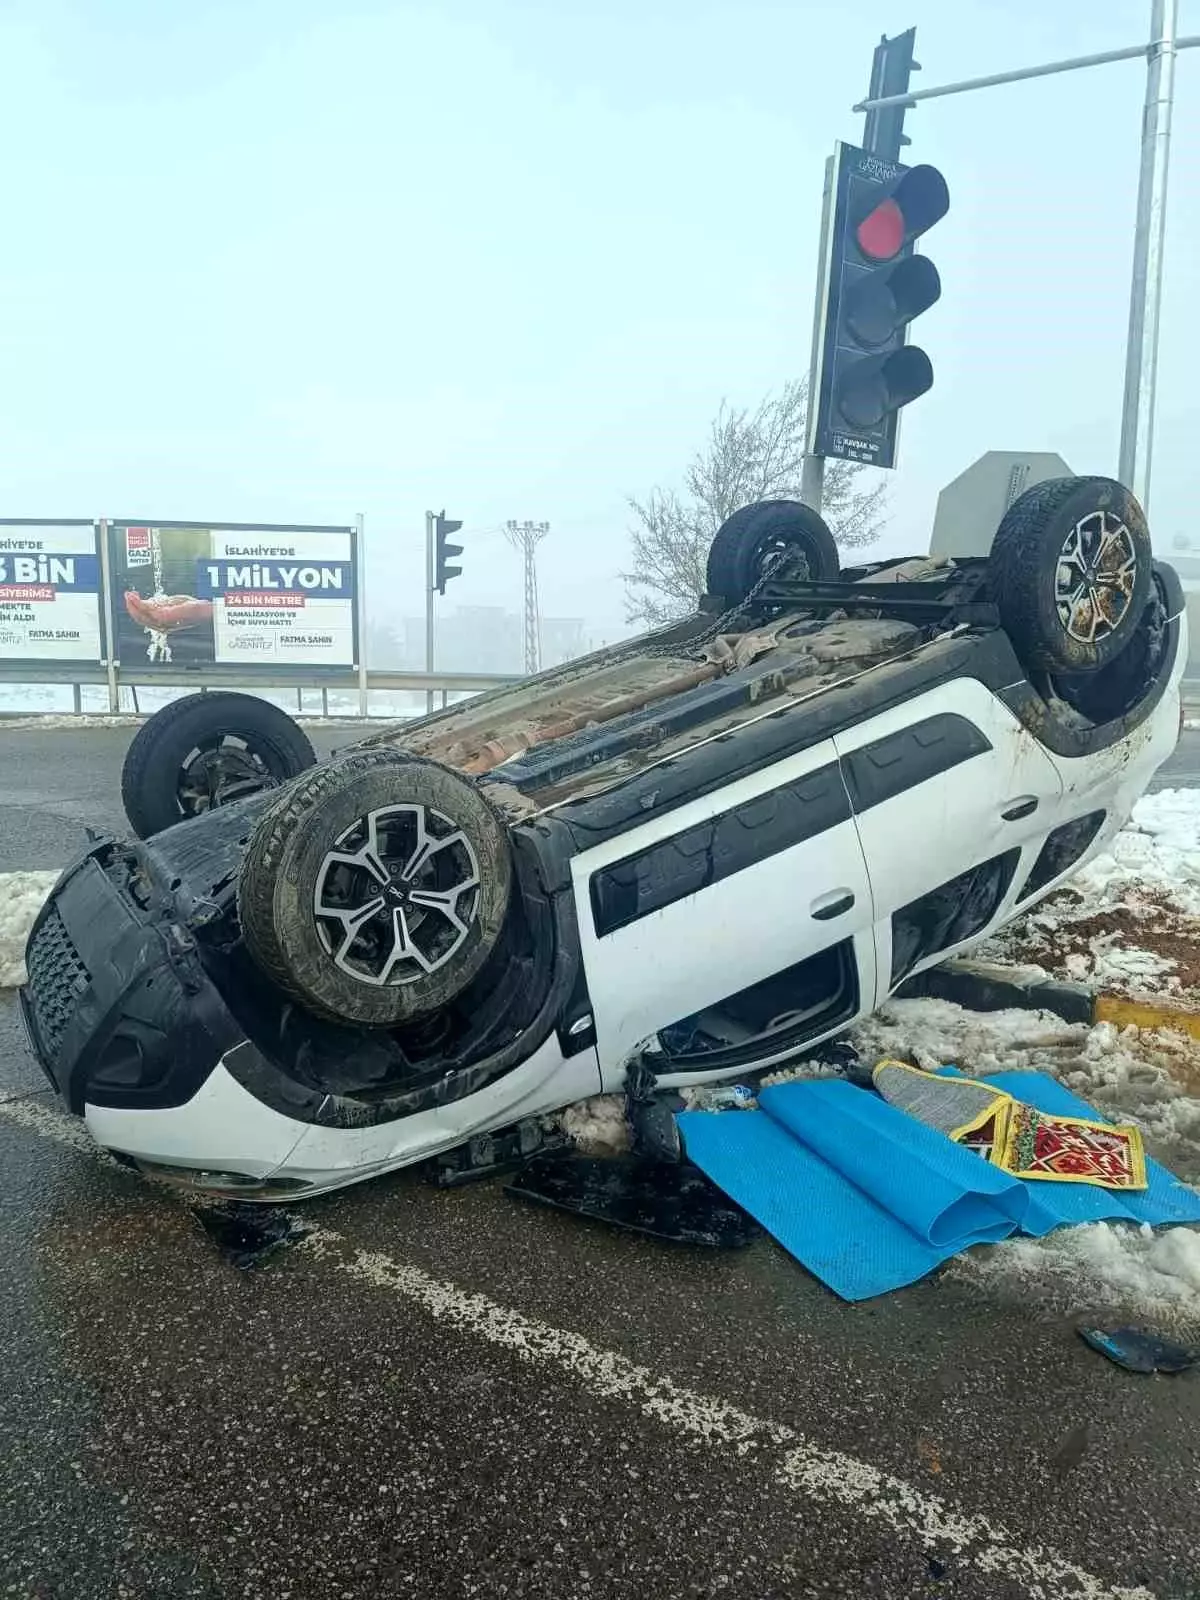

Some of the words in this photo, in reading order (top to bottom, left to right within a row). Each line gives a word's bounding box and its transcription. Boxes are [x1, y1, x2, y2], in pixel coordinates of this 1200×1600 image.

[225, 544, 296, 556] İSLAHİYE'DE
[14, 554, 75, 584] BİN
[207, 566, 220, 588] 1
[227, 564, 343, 589] MİLYON
[227, 595, 241, 605] 24
[243, 594, 262, 605] BİN
[264, 596, 302, 606] METRE
[13, 613, 36, 622] ALDI
[28, 629, 54, 638] FATMA
[280, 635, 306, 643] FATMA
